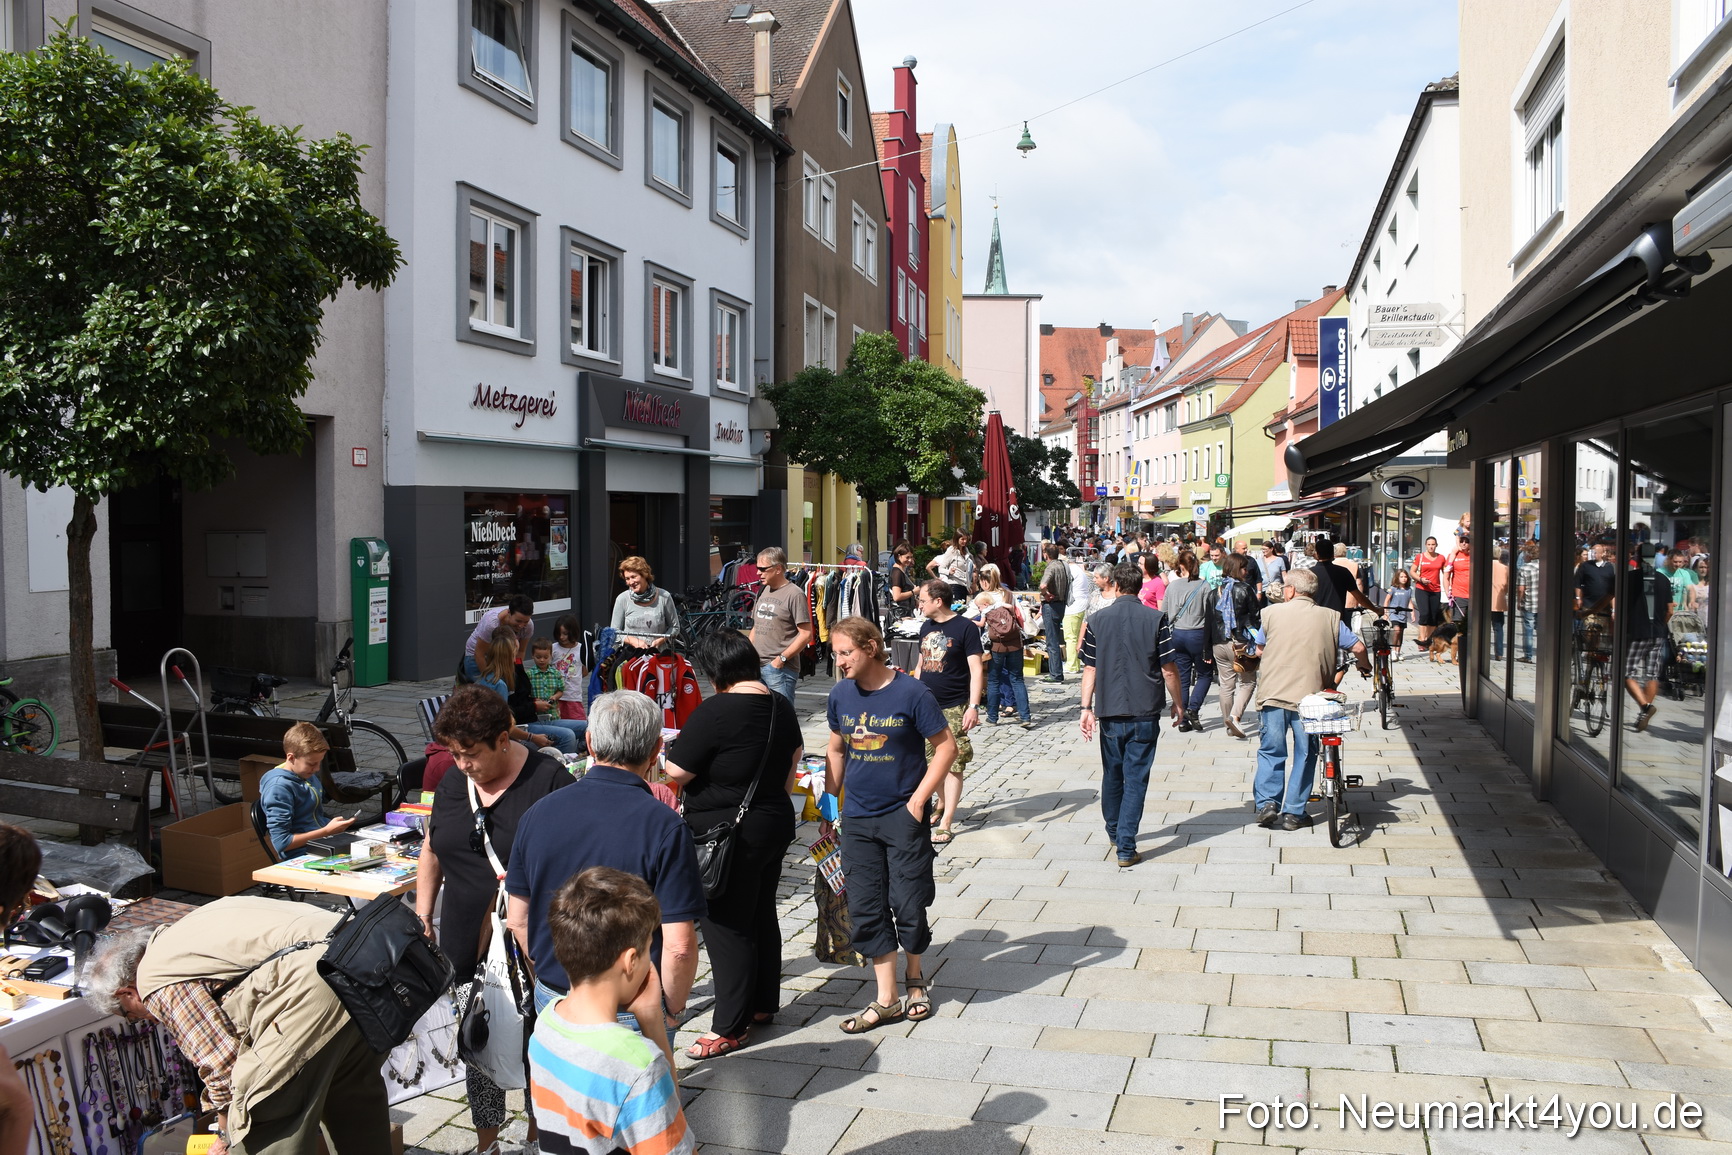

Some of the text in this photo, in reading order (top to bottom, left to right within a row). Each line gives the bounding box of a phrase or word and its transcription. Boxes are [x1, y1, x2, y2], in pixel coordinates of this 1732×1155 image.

[1374, 304, 1408, 313] Bauer's
[1380, 312, 1435, 322] Brillenstudio
[1338, 327, 1346, 386] TAILOR
[472, 382, 558, 429] Metzgerei
[622, 387, 682, 428] Nießlbeck
[715, 419, 744, 443] Imbiss
[471, 521, 517, 542] Nießlbeck
[841, 714, 904, 728] The Beatles
